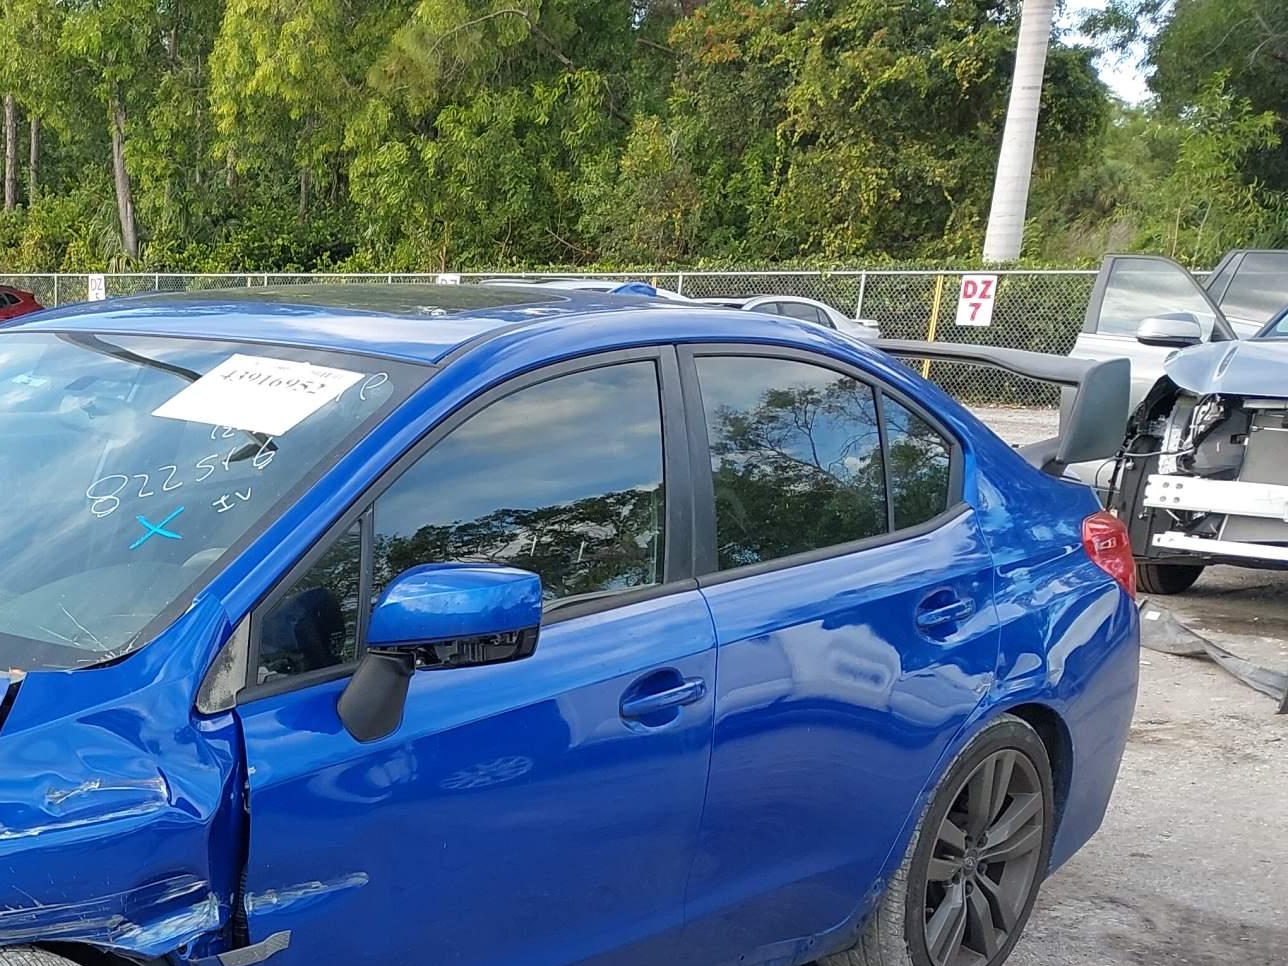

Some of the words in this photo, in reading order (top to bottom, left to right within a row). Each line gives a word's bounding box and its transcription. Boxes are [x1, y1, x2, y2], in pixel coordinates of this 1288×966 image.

[90, 278, 103, 291] DZ
[962, 280, 993, 299] DZ
[969, 302, 982, 321] 7
